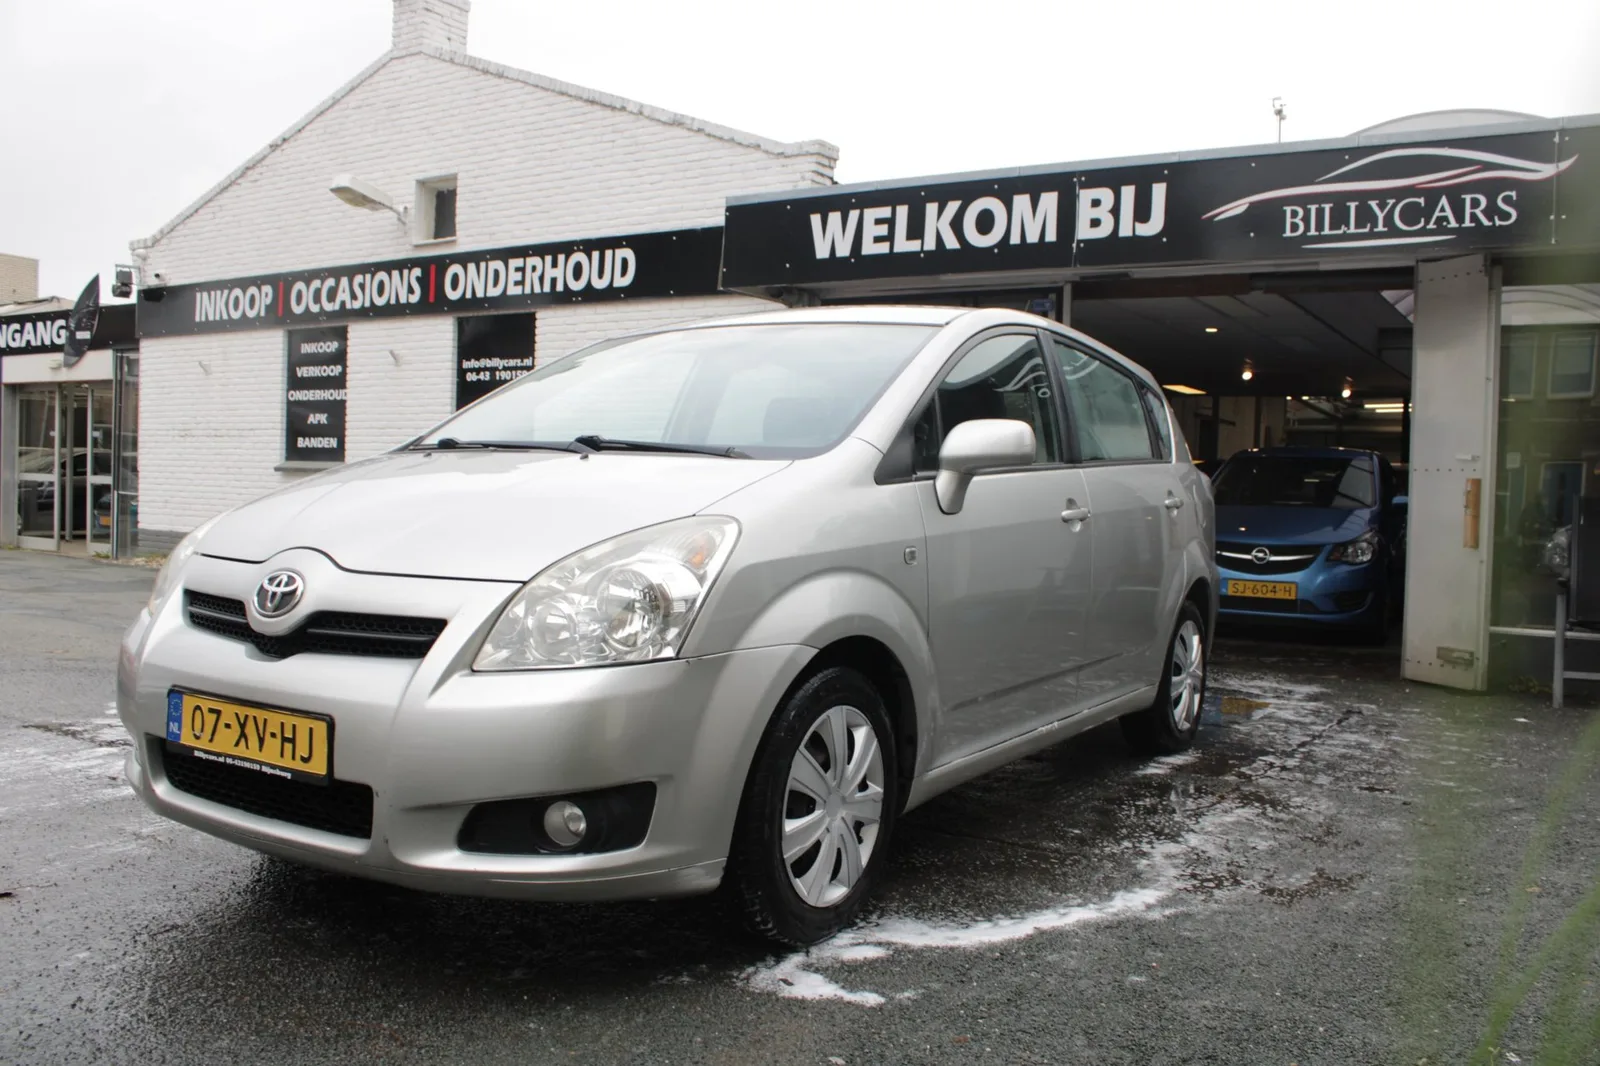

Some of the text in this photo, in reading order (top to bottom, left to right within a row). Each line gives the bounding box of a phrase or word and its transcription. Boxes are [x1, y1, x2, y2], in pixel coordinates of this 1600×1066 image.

[809, 181, 1168, 260] WELKOM BIJ
[1282, 190, 1519, 238] BILLYCARS
[194, 247, 637, 323] INKOOP OCCASIONS ONDERHOUD
[301, 341, 339, 354] INKOOP
[462, 356, 533, 369] info@billycars.nl
[296, 364, 342, 378] VERKOOP
[466, 371, 491, 382] 06-43
[307, 413, 328, 425] APK
[297, 437, 338, 449] BANDEN
[1232, 582, 1292, 597] SJ-604-H
[169, 721, 181, 734] NL
[191, 704, 314, 764] 07-XV-HJ
